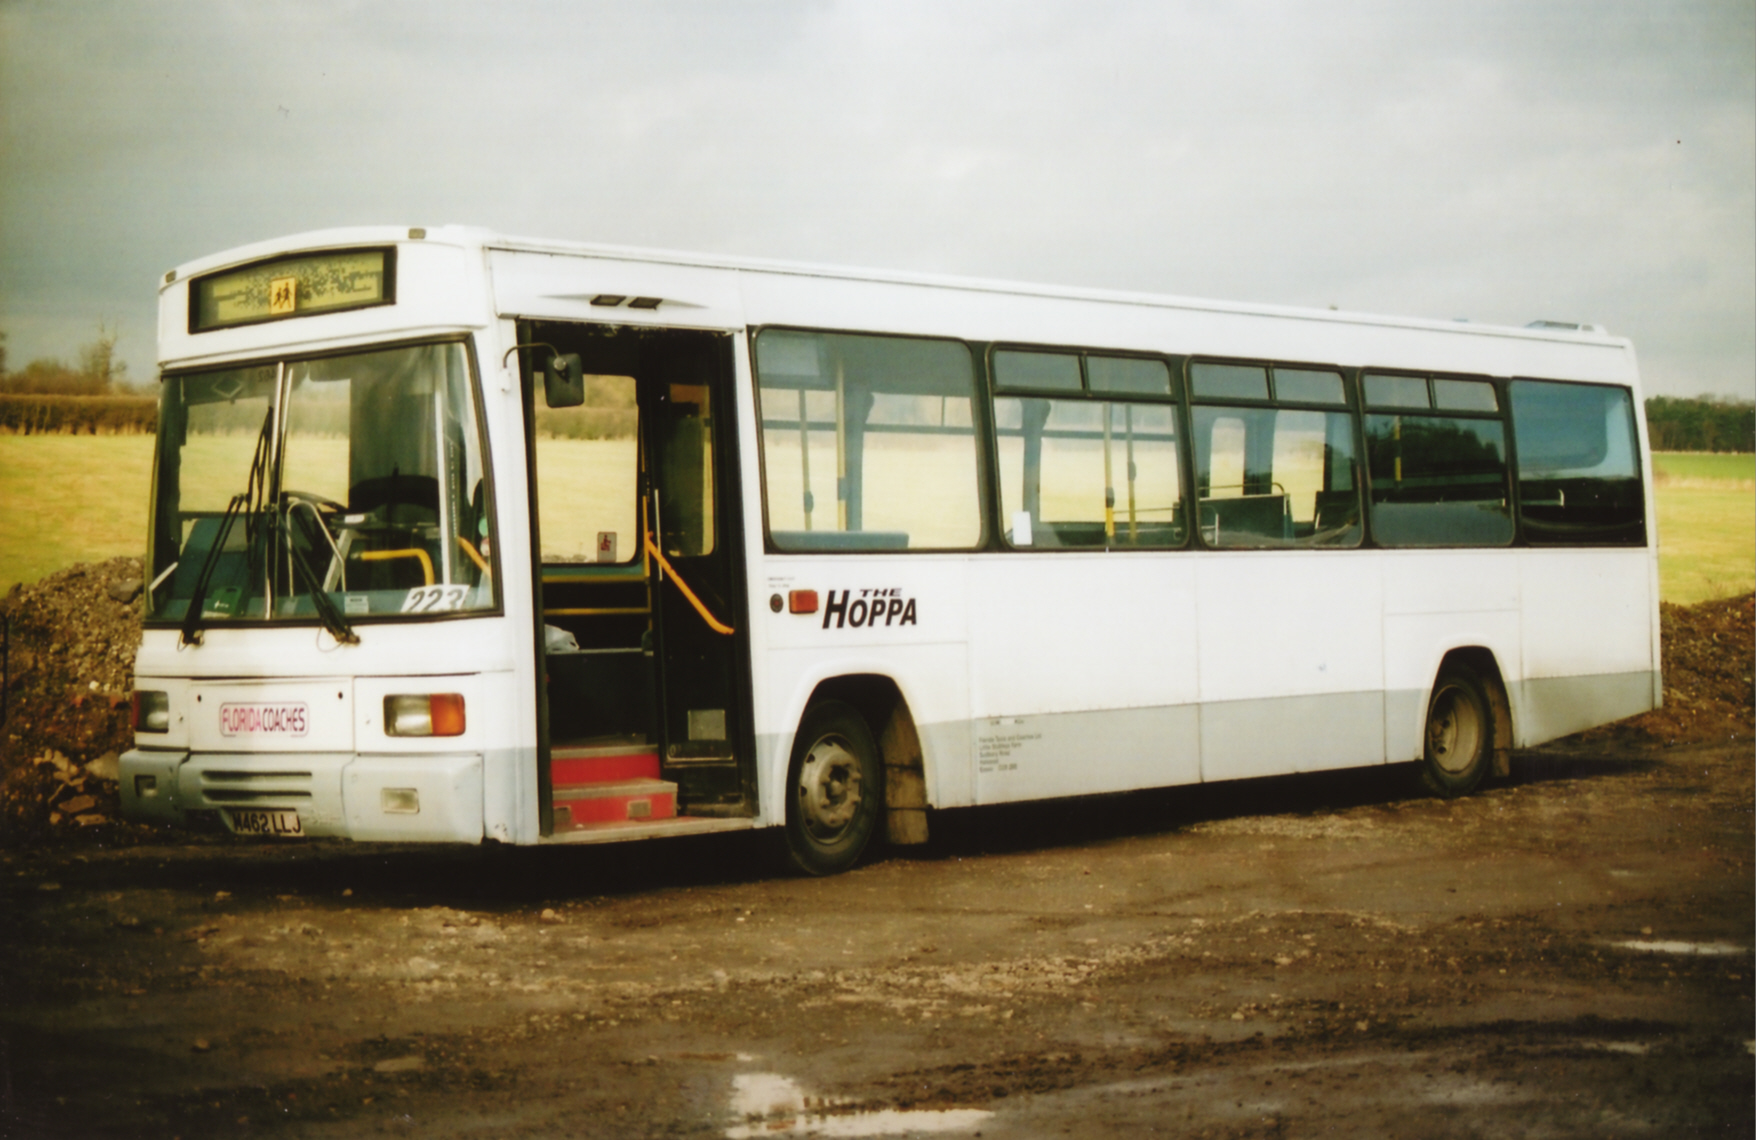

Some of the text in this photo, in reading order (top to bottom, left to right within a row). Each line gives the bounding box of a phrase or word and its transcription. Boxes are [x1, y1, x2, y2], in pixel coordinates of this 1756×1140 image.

[860, 588, 902, 597] THE
[822, 589, 917, 629] HOPPA
[222, 707, 305, 732] FLORIDA COACHES
[272, 813, 302, 834] LLJ
